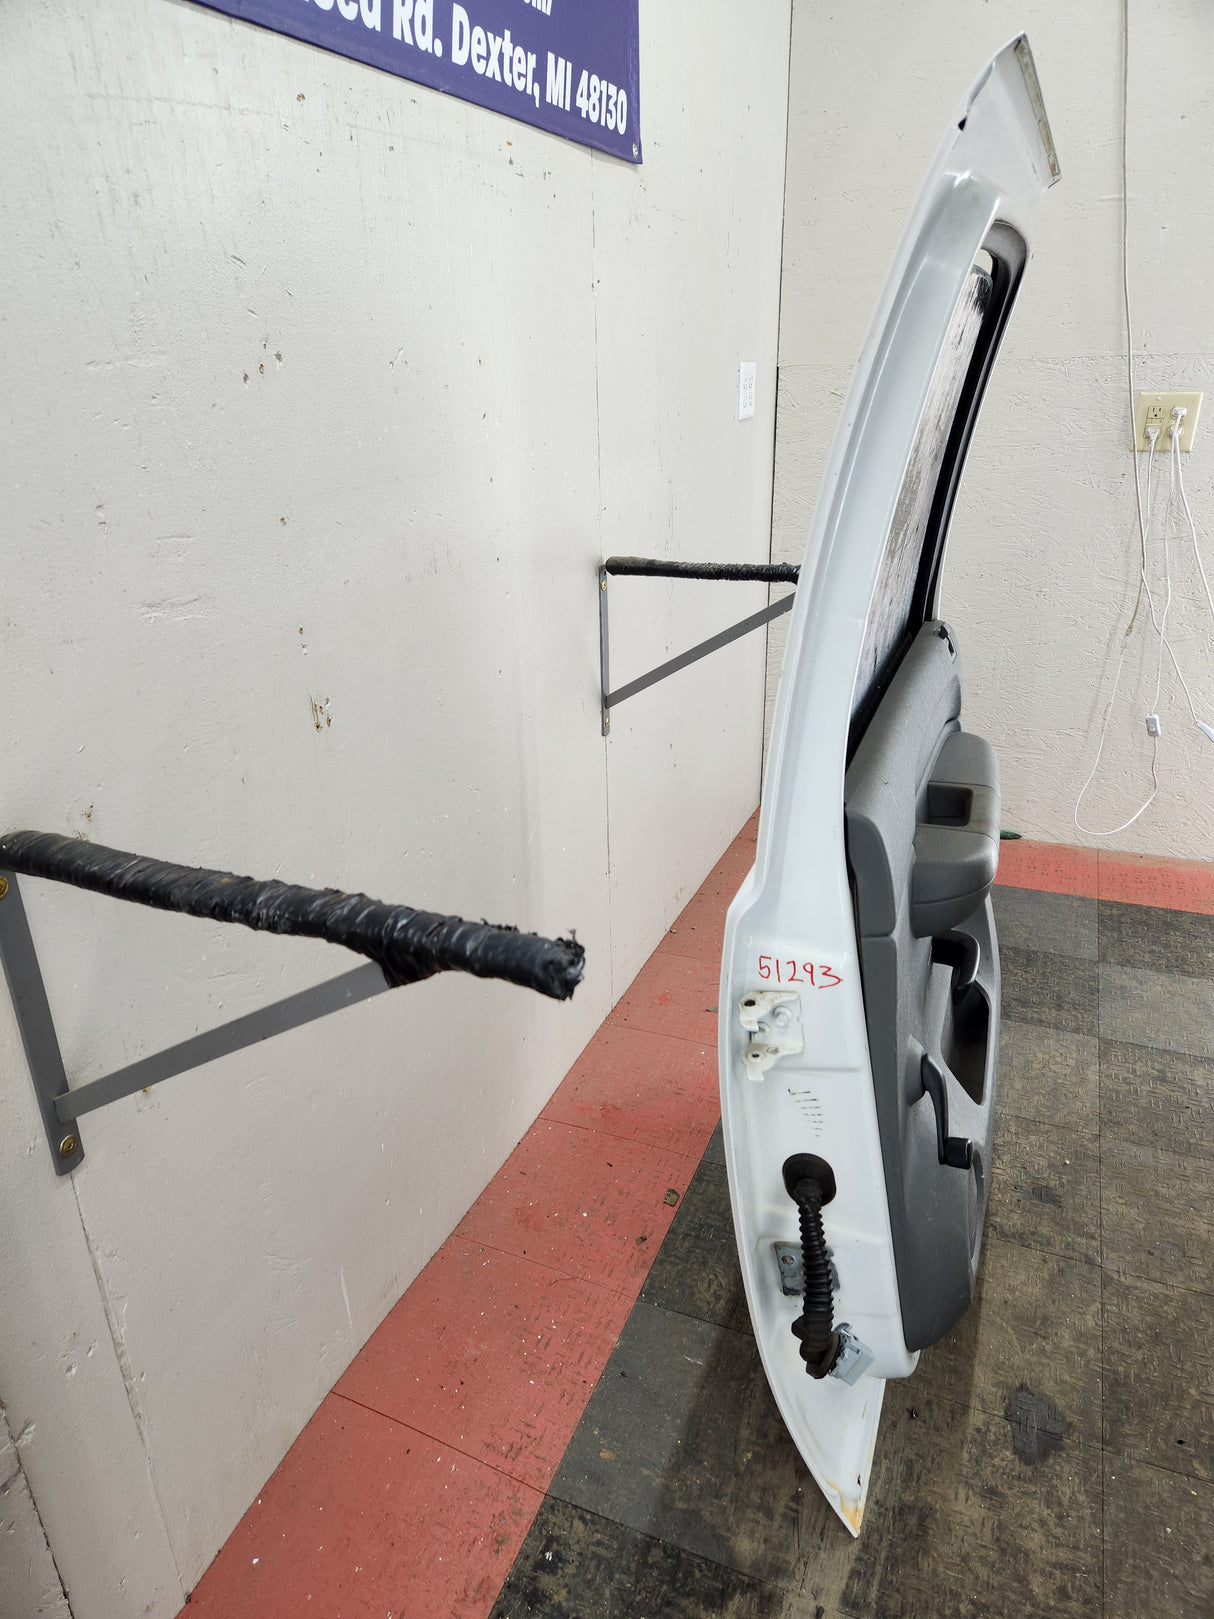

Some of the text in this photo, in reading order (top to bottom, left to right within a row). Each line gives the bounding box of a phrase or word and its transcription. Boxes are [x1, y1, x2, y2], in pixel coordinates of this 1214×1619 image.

[393, 0, 443, 58] Rd.
[451, 2, 540, 108] Dexter,
[545, 51, 572, 112] MI
[575, 69, 628, 135] 48130
[758, 955, 843, 989] 51293
